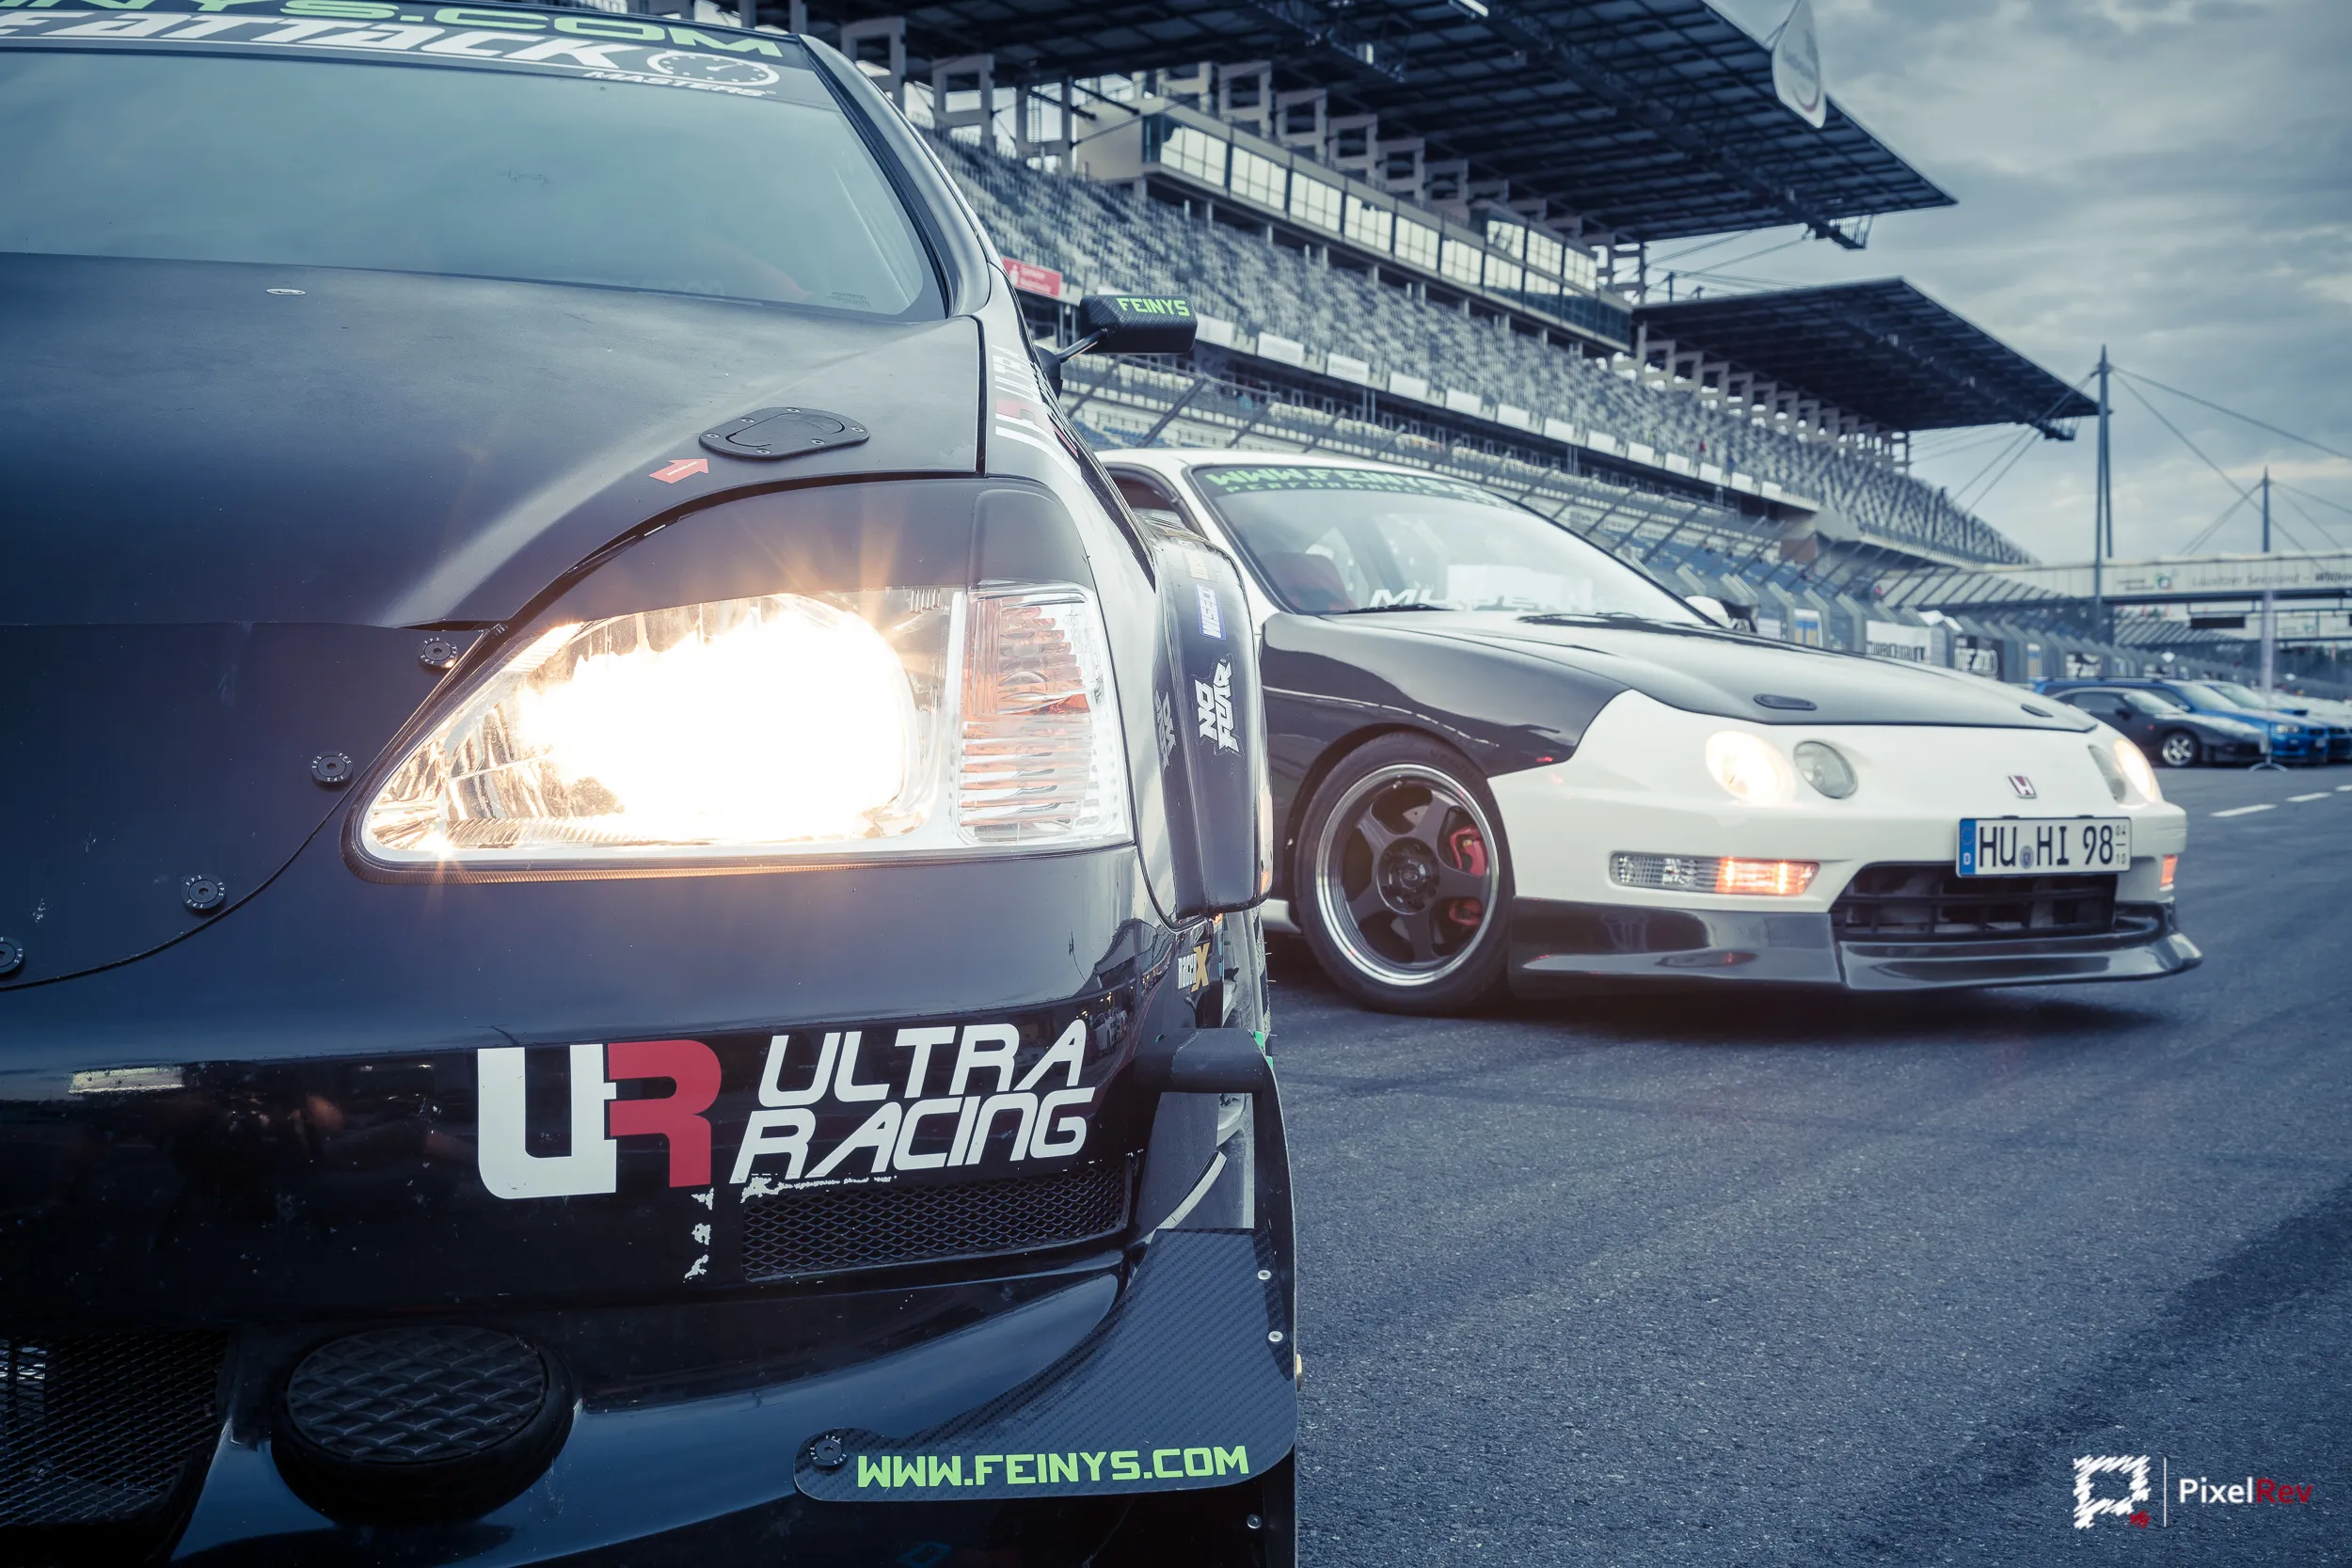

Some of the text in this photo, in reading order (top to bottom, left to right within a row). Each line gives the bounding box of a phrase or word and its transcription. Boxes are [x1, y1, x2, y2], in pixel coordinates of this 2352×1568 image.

[582, 71, 766, 97] MASTERS
[1116, 297, 1190, 317] FEINYS
[1195, 679, 1218, 741] NO
[1963, 852, 1971, 865] D
[1979, 825, 2113, 867] HU HI 98
[478, 1019, 1088, 1199] UR ULTRA
[729, 1086, 1095, 1184] RACING
[857, 1445, 1249, 1487] WWW.FEINYS.COM
